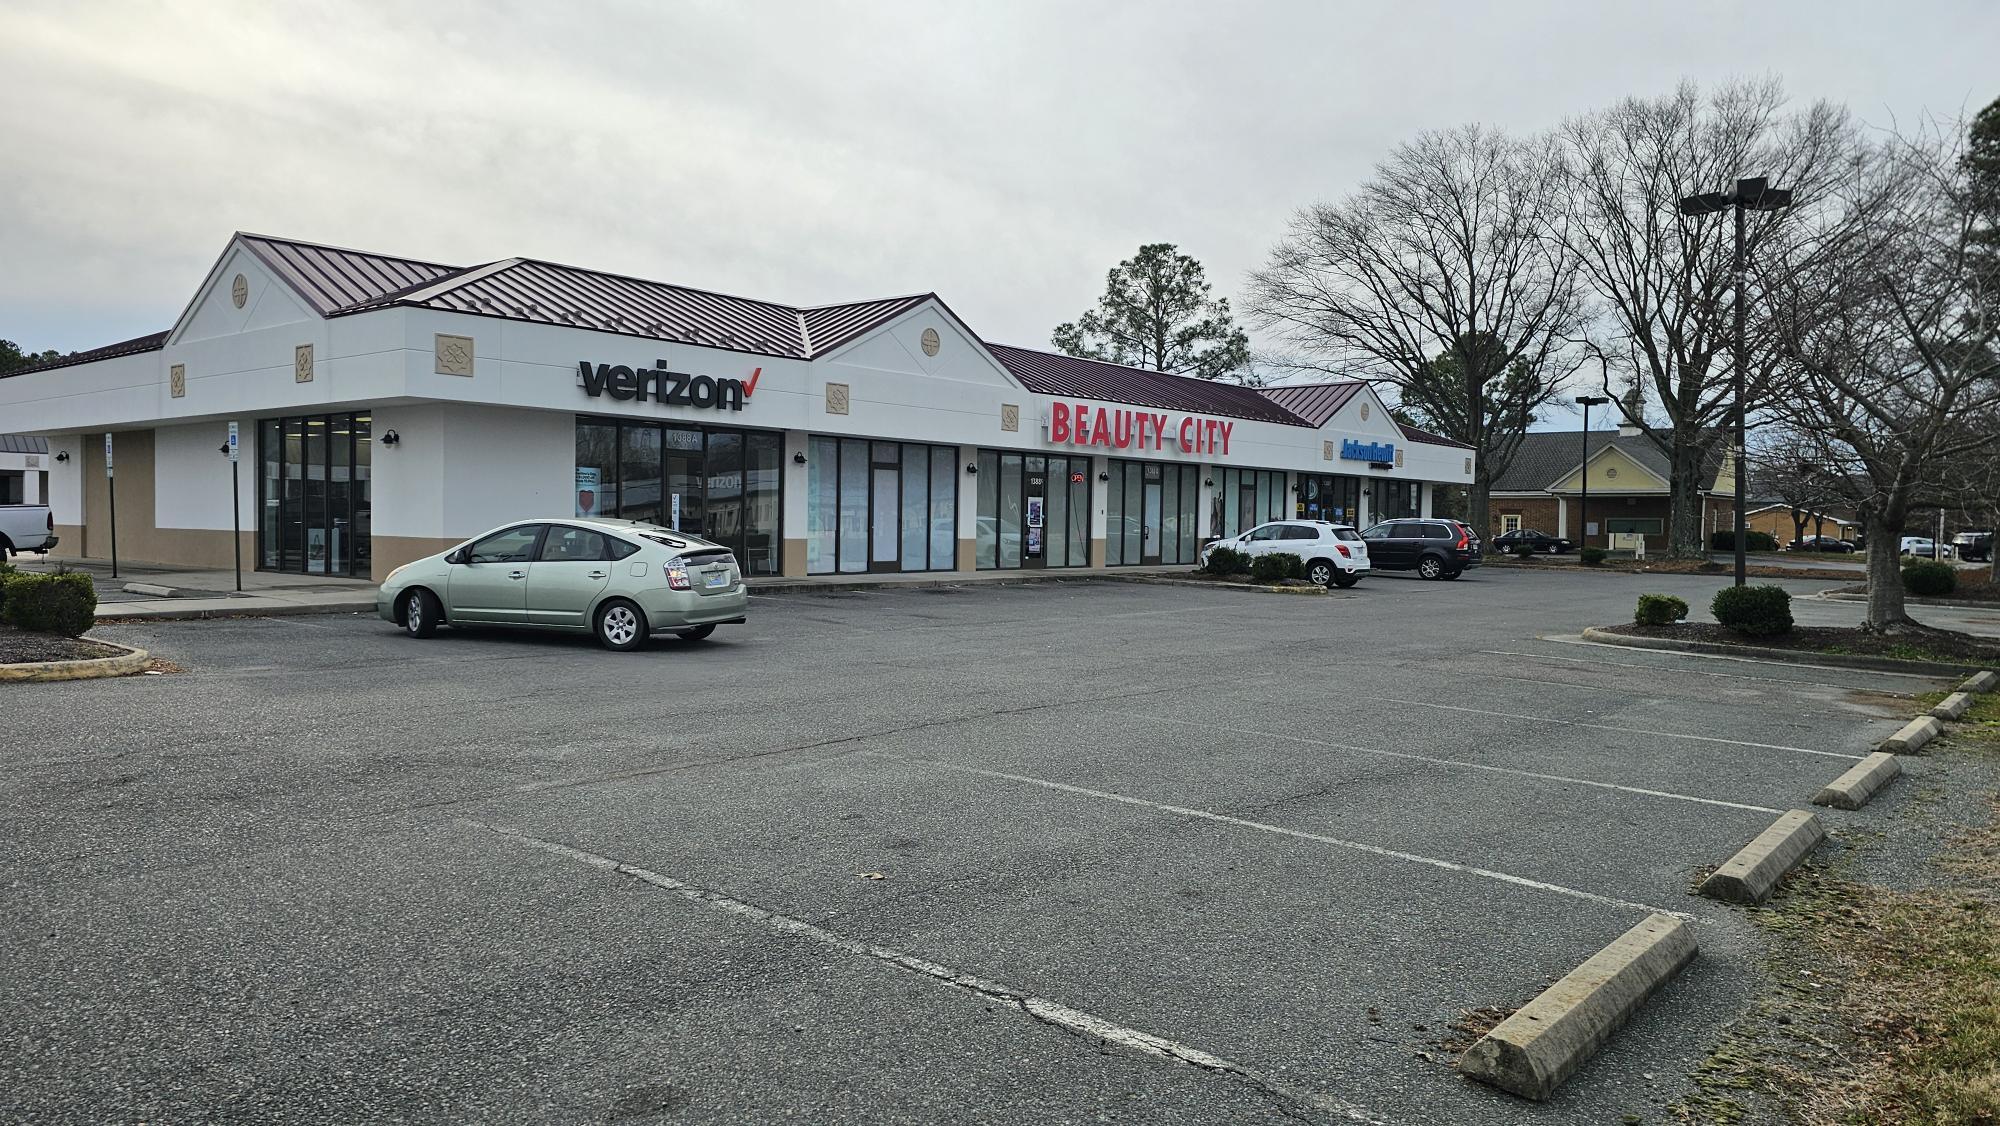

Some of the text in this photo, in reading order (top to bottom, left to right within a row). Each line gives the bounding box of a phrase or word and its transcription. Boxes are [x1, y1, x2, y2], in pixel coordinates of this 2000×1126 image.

[579, 359, 743, 411] verizon
[1050, 401, 1234, 455] BEAUTY CITY
